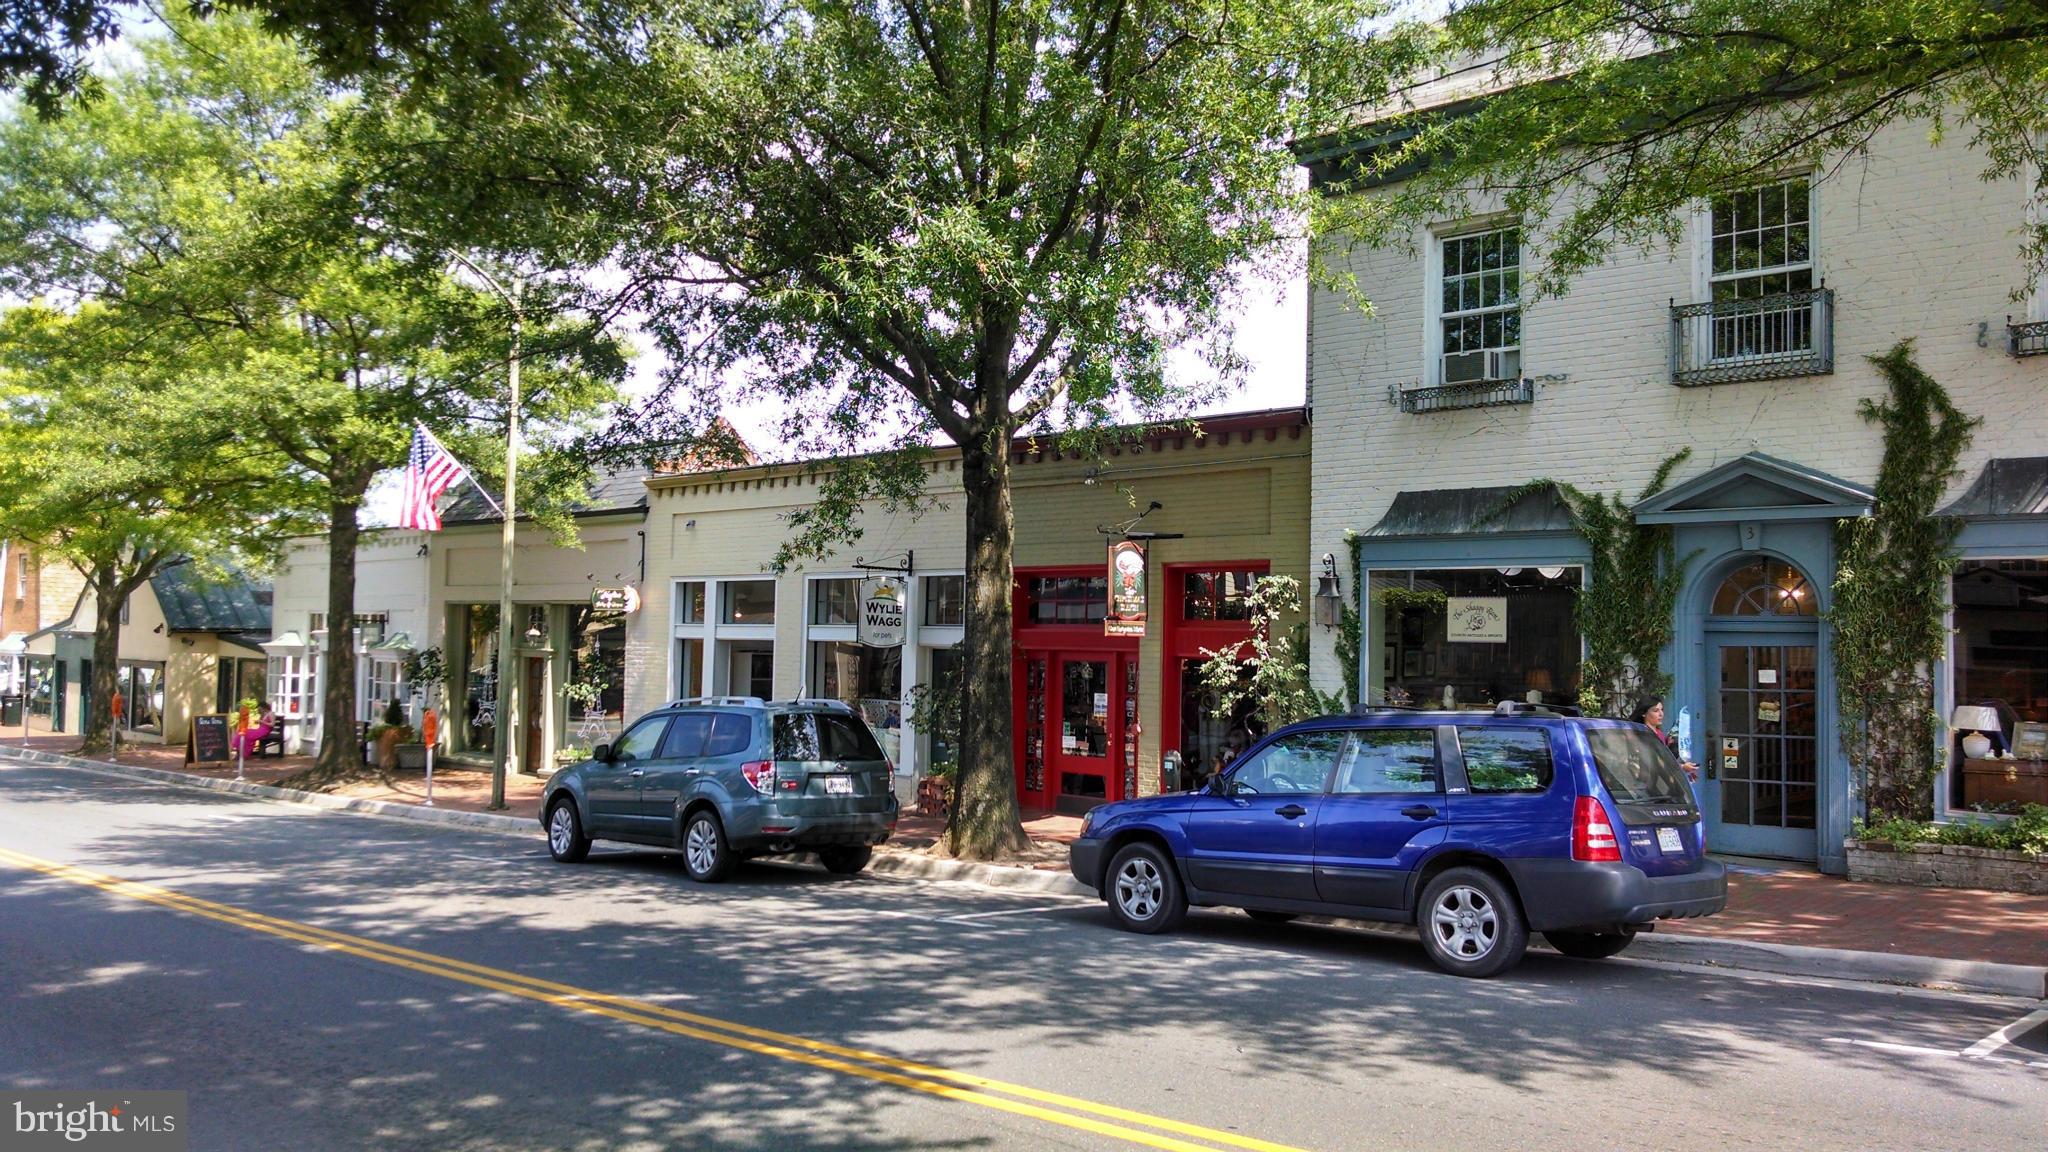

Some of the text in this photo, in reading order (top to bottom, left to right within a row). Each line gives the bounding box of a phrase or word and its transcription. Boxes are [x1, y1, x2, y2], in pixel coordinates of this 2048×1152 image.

[1746, 526, 1754, 540] 3
[866, 602, 902, 614] WYLIE
[866, 615, 902, 627] WAGG
